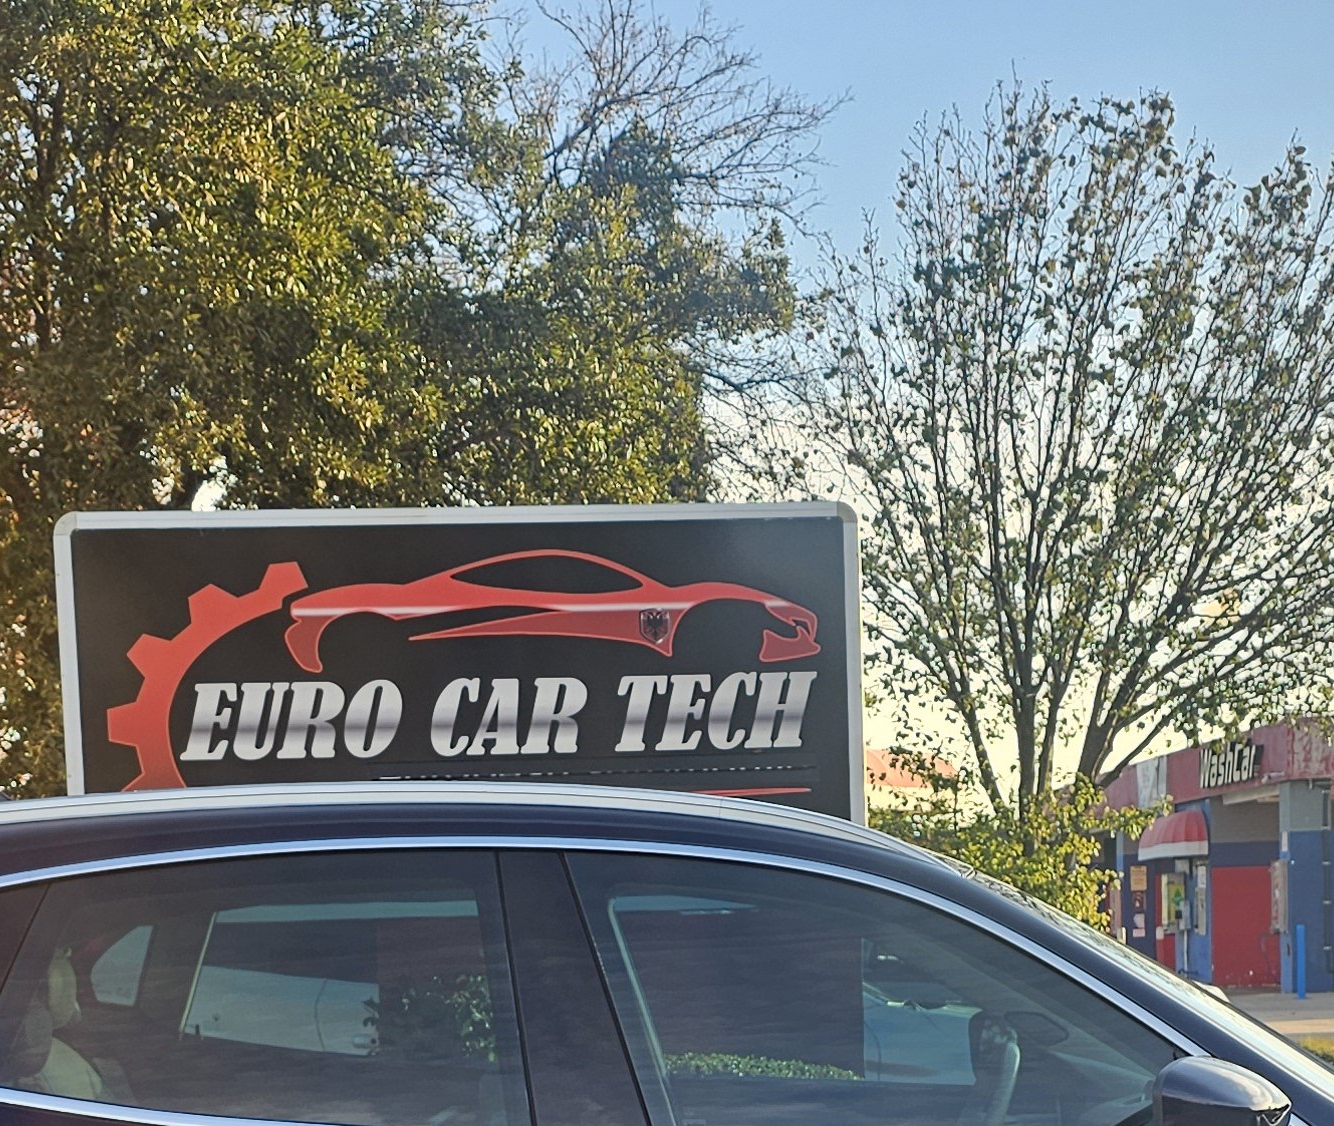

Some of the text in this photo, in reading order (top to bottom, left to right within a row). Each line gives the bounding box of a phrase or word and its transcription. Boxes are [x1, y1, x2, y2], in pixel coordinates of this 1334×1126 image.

[179, 670, 818, 763] EURO CAR TECH
